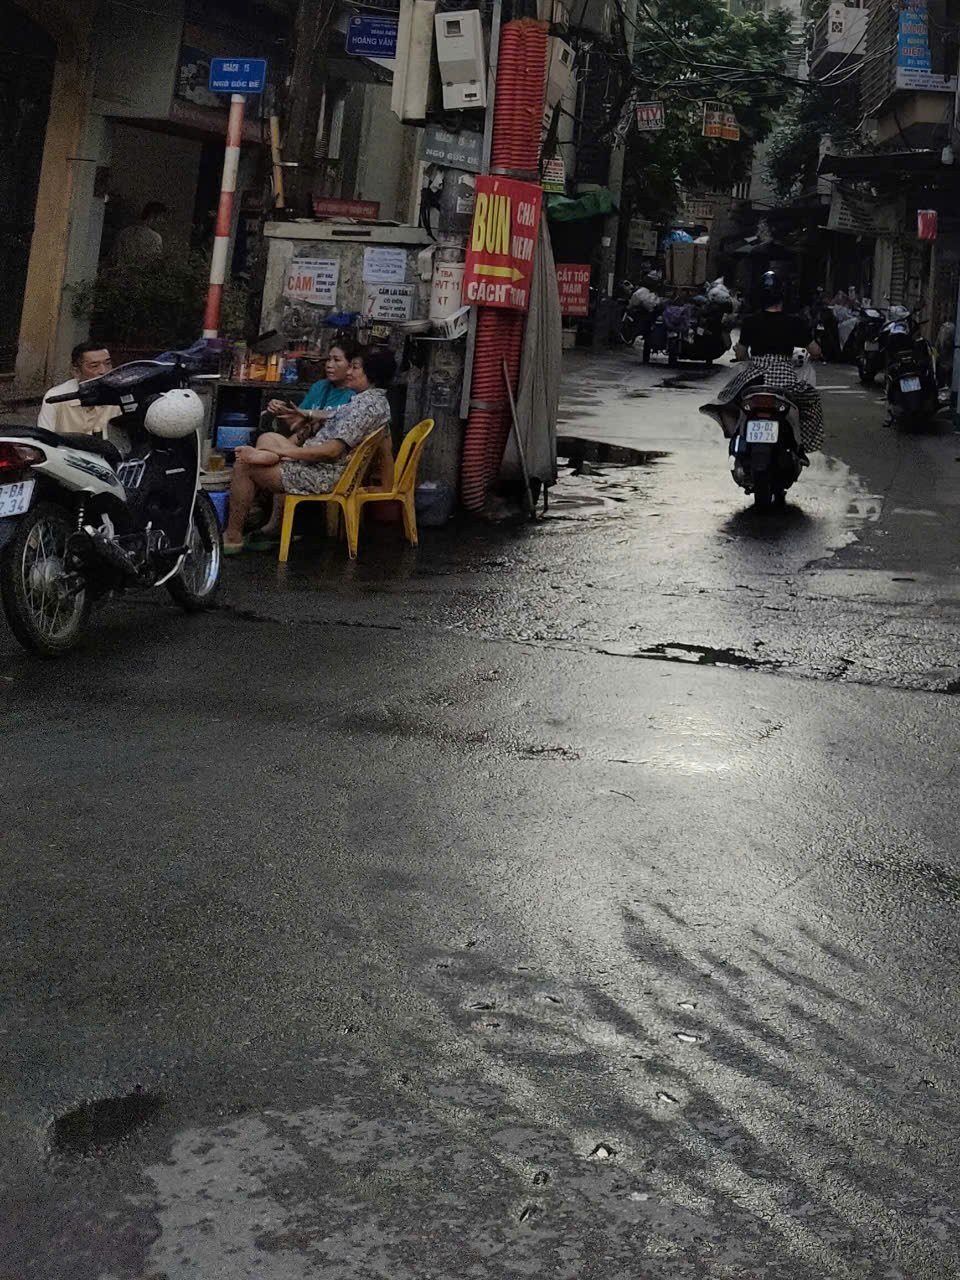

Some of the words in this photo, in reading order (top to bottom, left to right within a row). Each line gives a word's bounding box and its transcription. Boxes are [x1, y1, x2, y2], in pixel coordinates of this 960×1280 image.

[472, 181, 511, 256] BÚN
[517, 196, 537, 228] CHẢ
[512, 235, 535, 262] NEM
[574, 269, 589, 282] TÓC
[467, 279, 506, 303] CÁCH
